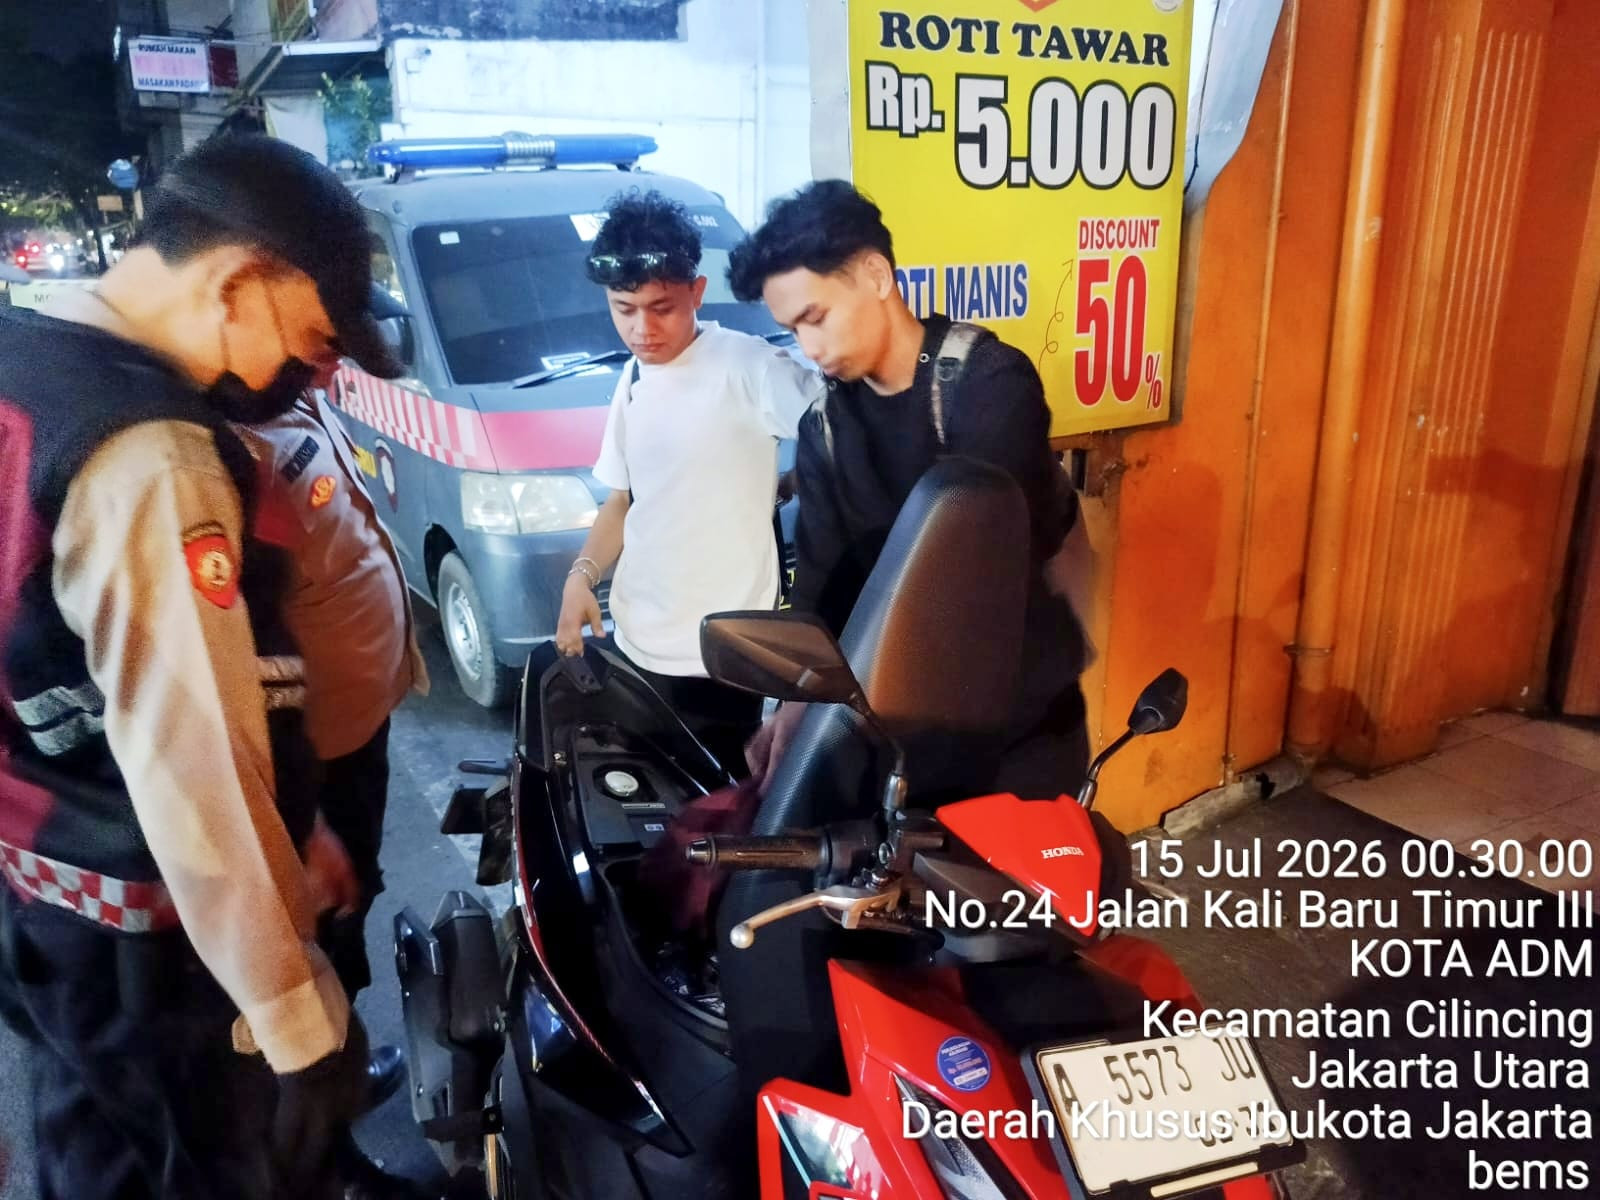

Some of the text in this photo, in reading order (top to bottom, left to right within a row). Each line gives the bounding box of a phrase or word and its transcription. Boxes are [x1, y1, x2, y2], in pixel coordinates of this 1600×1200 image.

[167, 45, 197, 54] MAKAN
[879, 11, 1170, 67] ROTI TAWAR
[864, 59, 1177, 191] Rp. 5.000
[1078, 219, 1161, 251] DISCOUNT
[945, 263, 1029, 321] MANIS
[1041, 846, 1084, 859] HONDA
[1053, 1063, 1083, 1116] A
[1103, 1045, 1192, 1105] 5573
